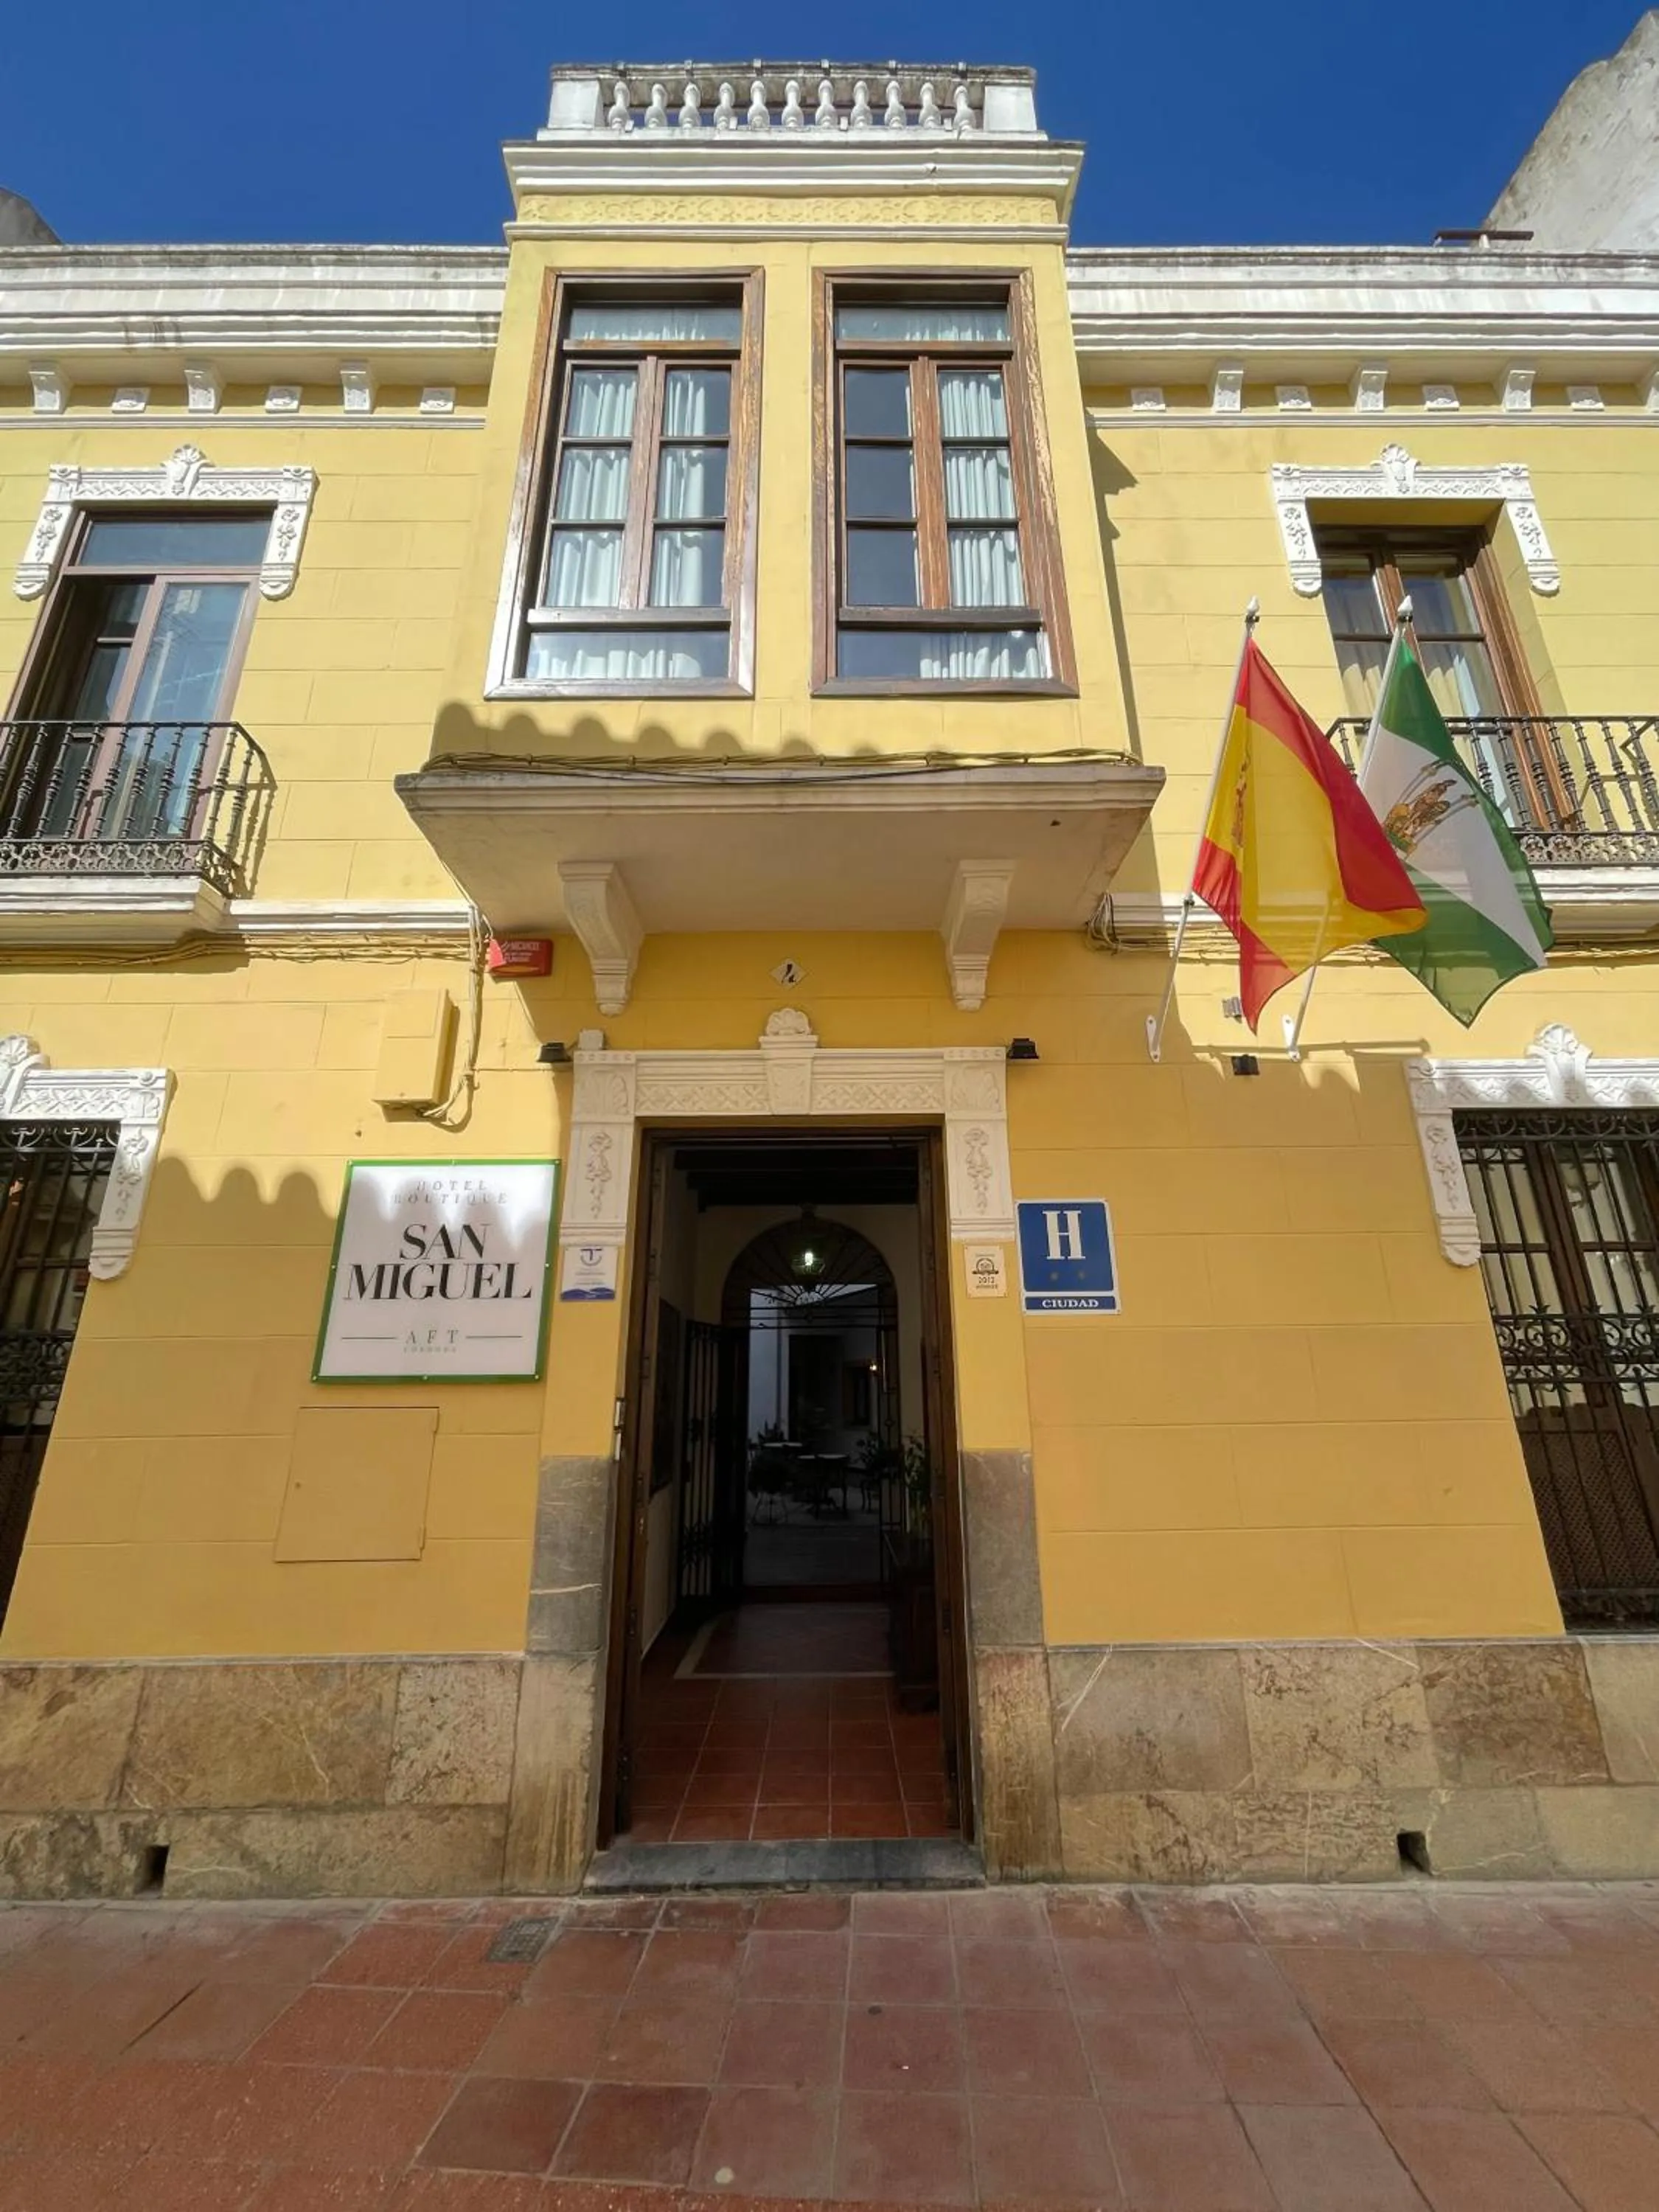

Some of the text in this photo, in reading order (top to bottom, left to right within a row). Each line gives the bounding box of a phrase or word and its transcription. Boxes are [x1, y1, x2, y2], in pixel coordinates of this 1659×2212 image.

[417, 1180, 487, 1191] HOTEL
[394, 1194, 508, 1206] BOUTIQUE
[399, 1223, 490, 1260] SAN
[1043, 1211, 1086, 1259] H
[343, 1263, 532, 1300] MIGUEL
[1042, 1298, 1099, 1308] CIUDAD
